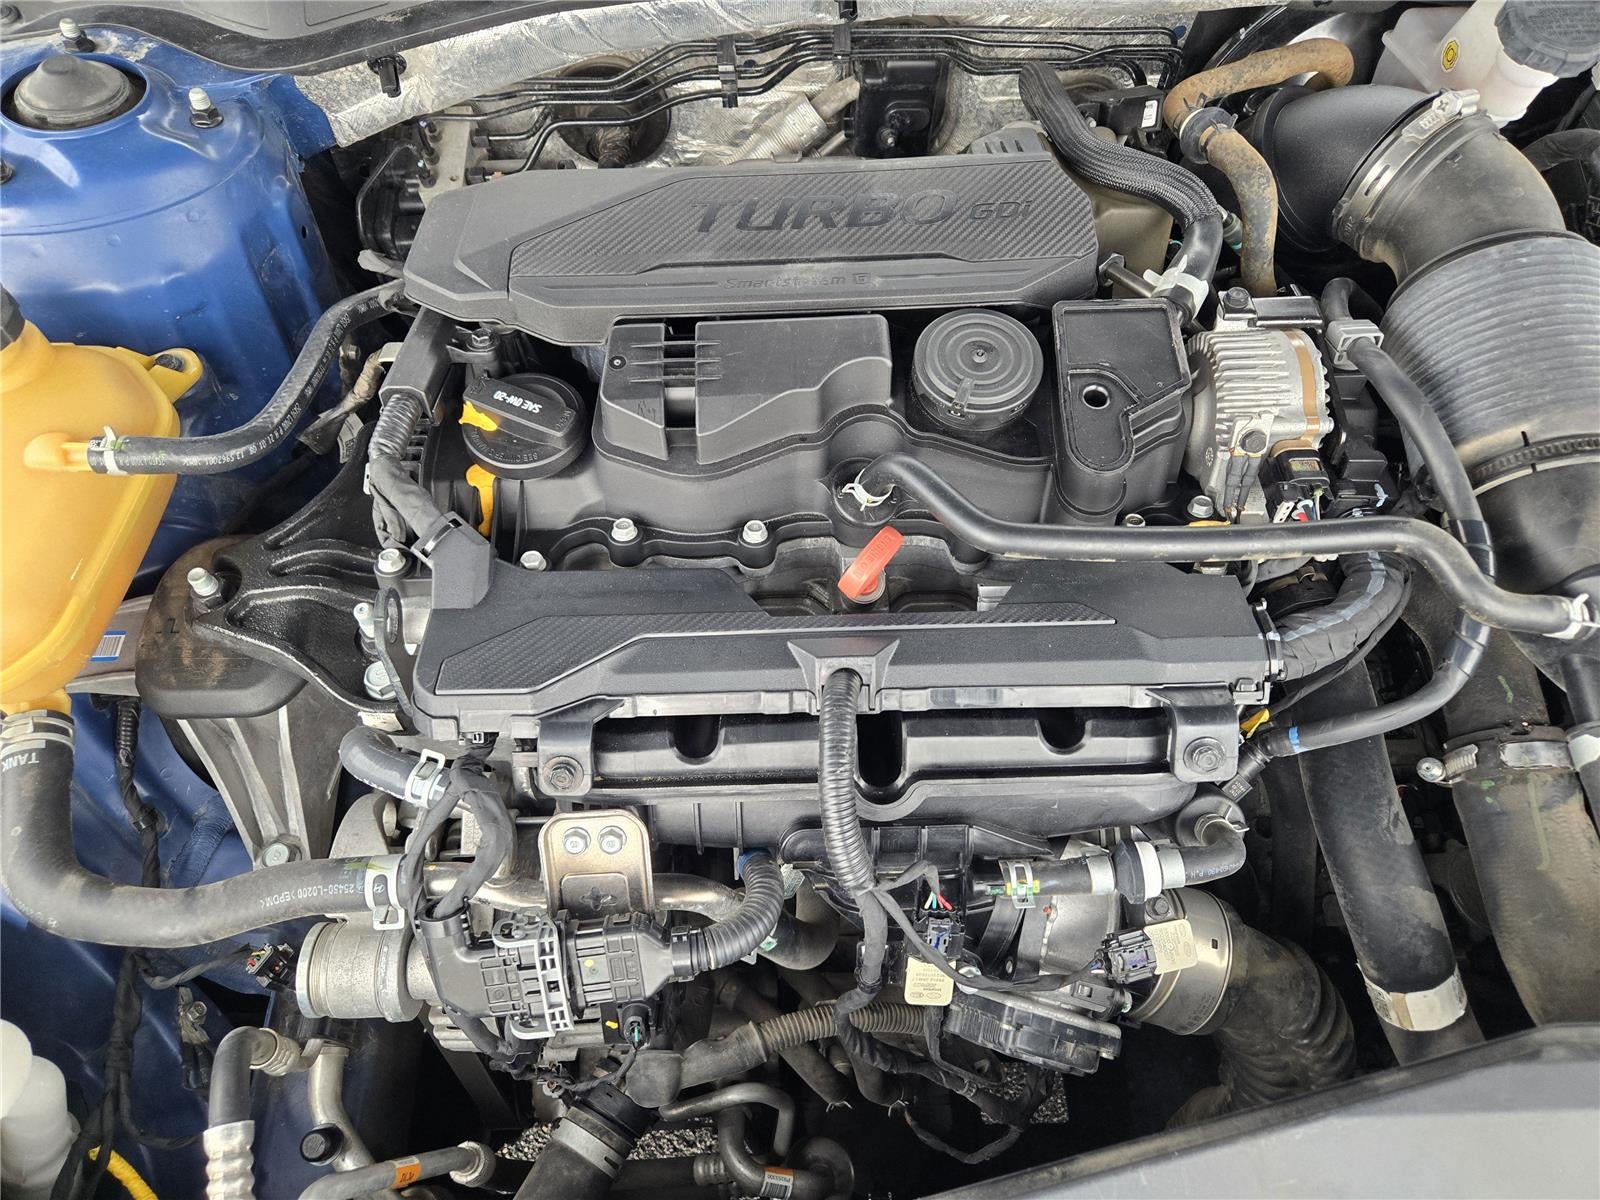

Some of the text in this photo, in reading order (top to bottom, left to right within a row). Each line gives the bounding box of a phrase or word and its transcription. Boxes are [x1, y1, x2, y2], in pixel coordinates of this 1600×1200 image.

[691, 189, 1032, 233] TURBO GDi
[493, 390, 543, 414] SAE 0W-20
[2, 752, 40, 772] TANK
[297, 883, 354, 899] 25450-L0200
